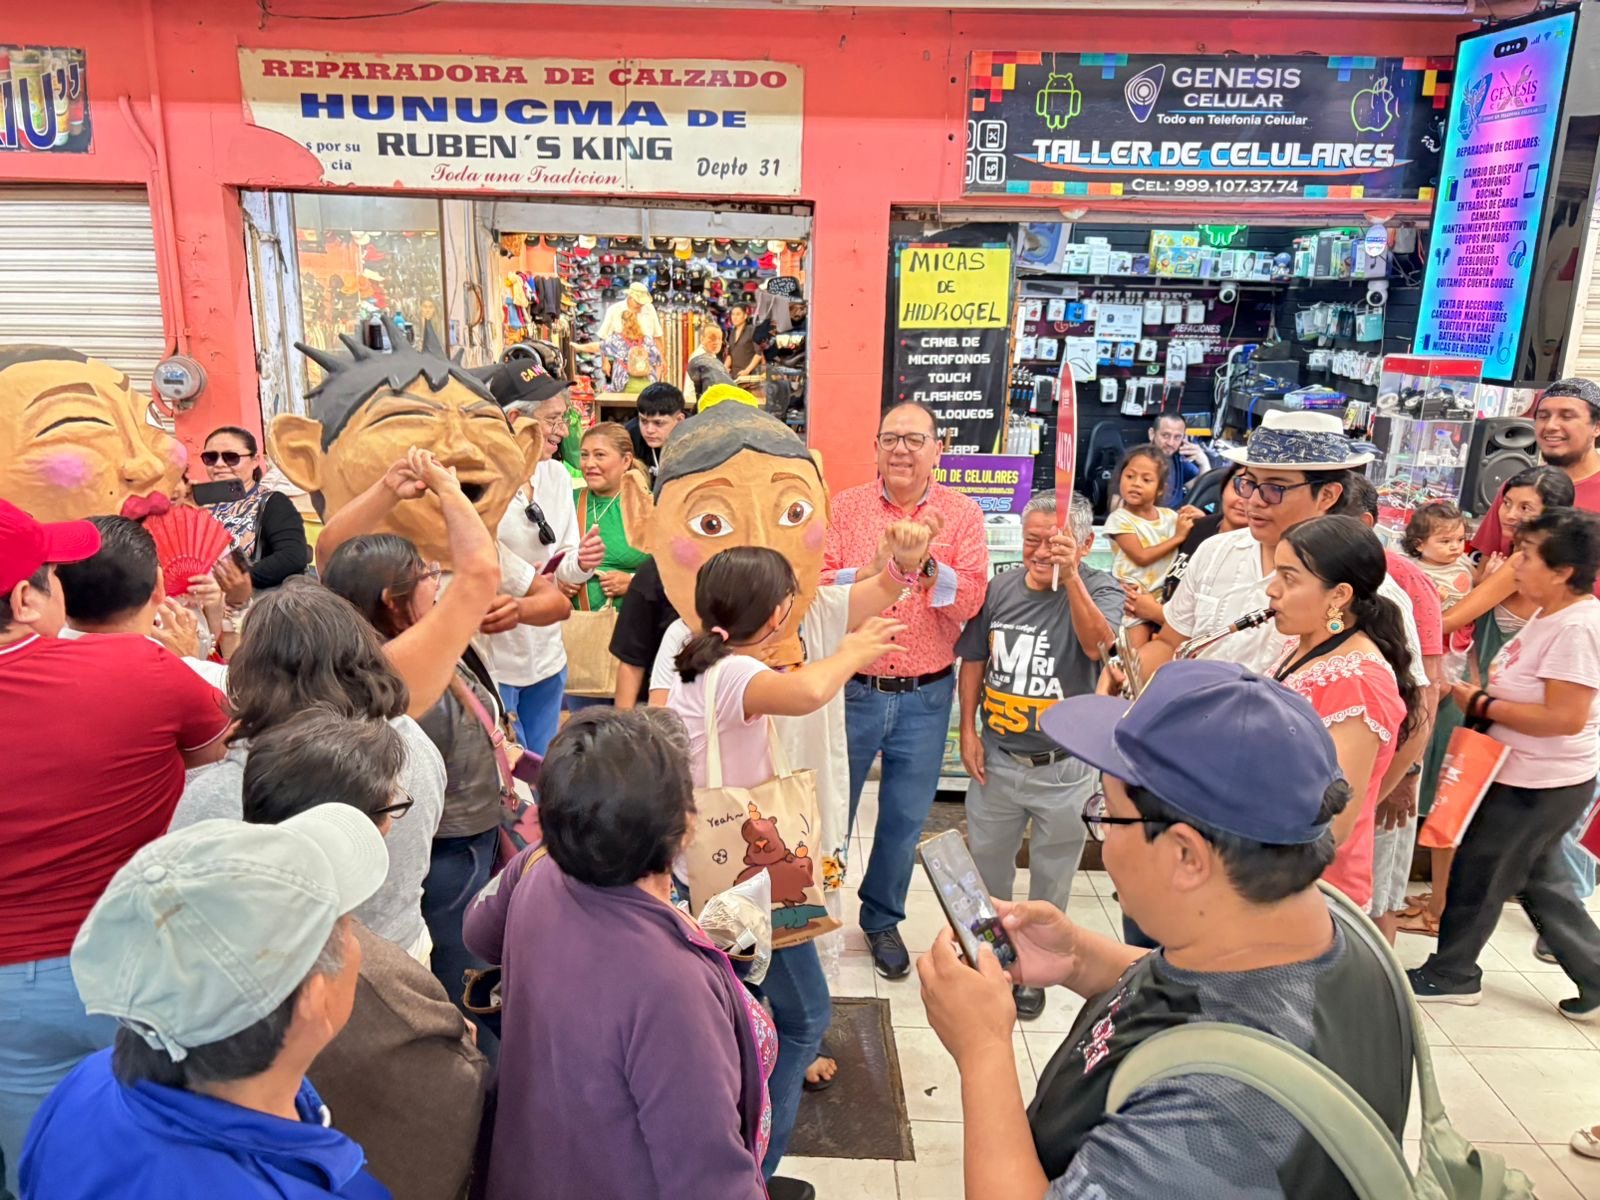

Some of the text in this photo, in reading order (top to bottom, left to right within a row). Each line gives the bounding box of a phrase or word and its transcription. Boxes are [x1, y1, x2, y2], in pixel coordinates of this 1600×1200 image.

[262, 59, 788, 89] REPARADORA DE CALZADO
[1171, 67, 1302, 90] GENESIS
[1183, 93, 1284, 108] CELULAR
[300, 92, 747, 129] HUNUCMA DE
[1156, 113, 1188, 125] Todo
[1189, 116, 1204, 125] en
[1264, 115, 1308, 125] Celular
[316, 141, 341, 153] por
[345, 143, 360, 152] su
[572, 136, 673, 161] KING
[1031, 139, 1395, 168] TALLER DE CELULARES
[1495, 141, 1502, 152] DE
[331, 160, 352, 170] cia
[697, 157, 781, 179] Depto 31
[1463, 162, 1523, 178] CAMBIO DE DISPLAY
[430, 163, 479, 184] Toda
[483, 168, 523, 185] una
[1131, 178, 1299, 194] CEL: 999.107.37.74
[1475, 187, 1503, 199] BOCINAS
[1457, 197, 1518, 212] ENTRADAS DE CARGA
[1442, 220, 1528, 234] MANTENIMIENTO PREVENTIVO
[1455, 233, 1480, 245] EQUIPOS
[1465, 244, 1495, 255] FLASHEOS
[908, 251, 985, 272] MICAS
[1457, 256, 1499, 266] DESBLOQUEOS
[937, 280, 956, 294] DE
[1437, 278, 1514, 288] QUITAMOS CUENTA GOOGLE
[1438, 299, 1456, 309] VENTA
[1457, 299, 1464, 309] DE
[902, 301, 1001, 325] HIDROGEL
[1486, 312, 1507, 322] LIBRES
[1438, 320, 1471, 331] BLUETOOTH
[1476, 323, 1495, 333] CABLE
[921, 336, 980, 347] CAMB. DE
[1467, 333, 1491, 344] FUNDAS
[1432, 341, 1451, 351] MICAS
[1451, 342, 1459, 352] DE
[1460, 343, 1488, 355] HIDROGEL
[908, 354, 990, 365] MICROFONOS
[928, 372, 971, 383] TOUCH
[913, 391, 982, 401] FLASHEOS
[1057, 432, 1072, 472] ALTO
[950, 469, 962, 483] DE
[964, 470, 1019, 484] CELULARES
